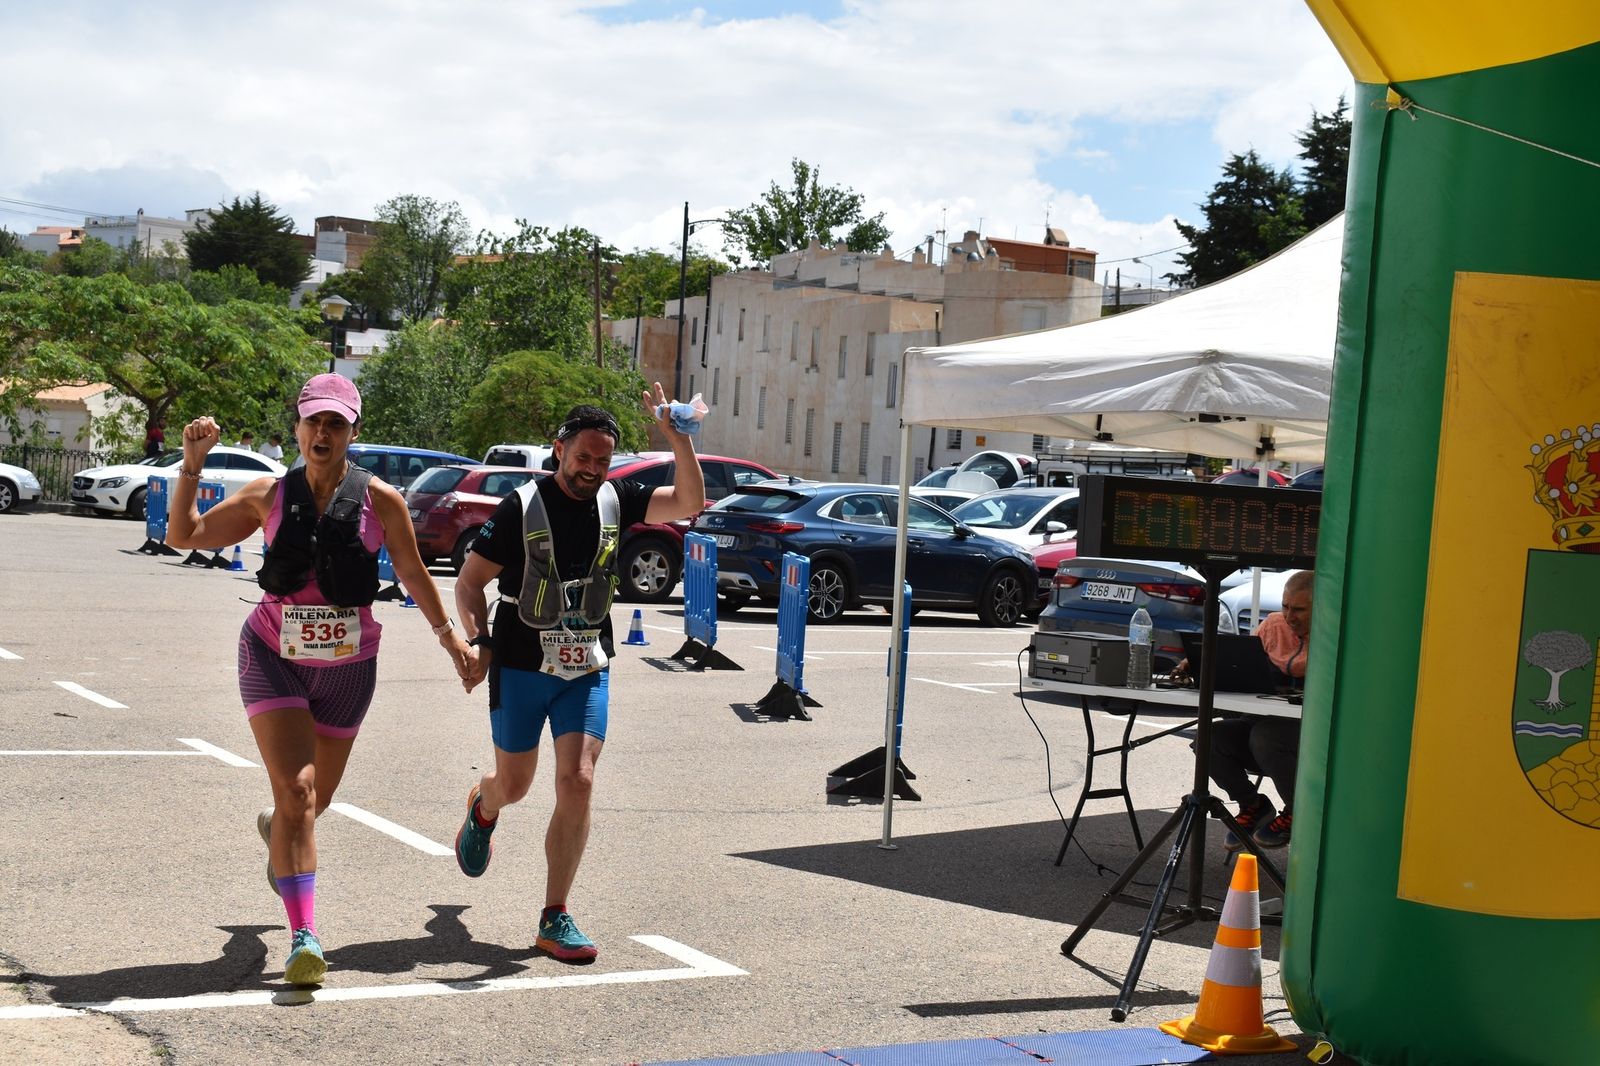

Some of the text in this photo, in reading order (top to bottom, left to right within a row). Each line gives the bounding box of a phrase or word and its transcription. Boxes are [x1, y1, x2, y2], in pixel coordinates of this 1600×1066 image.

[1087, 584, 1132, 599] 9268 JNT
[284, 609, 357, 620] MILENARIA
[301, 622, 347, 641] 536
